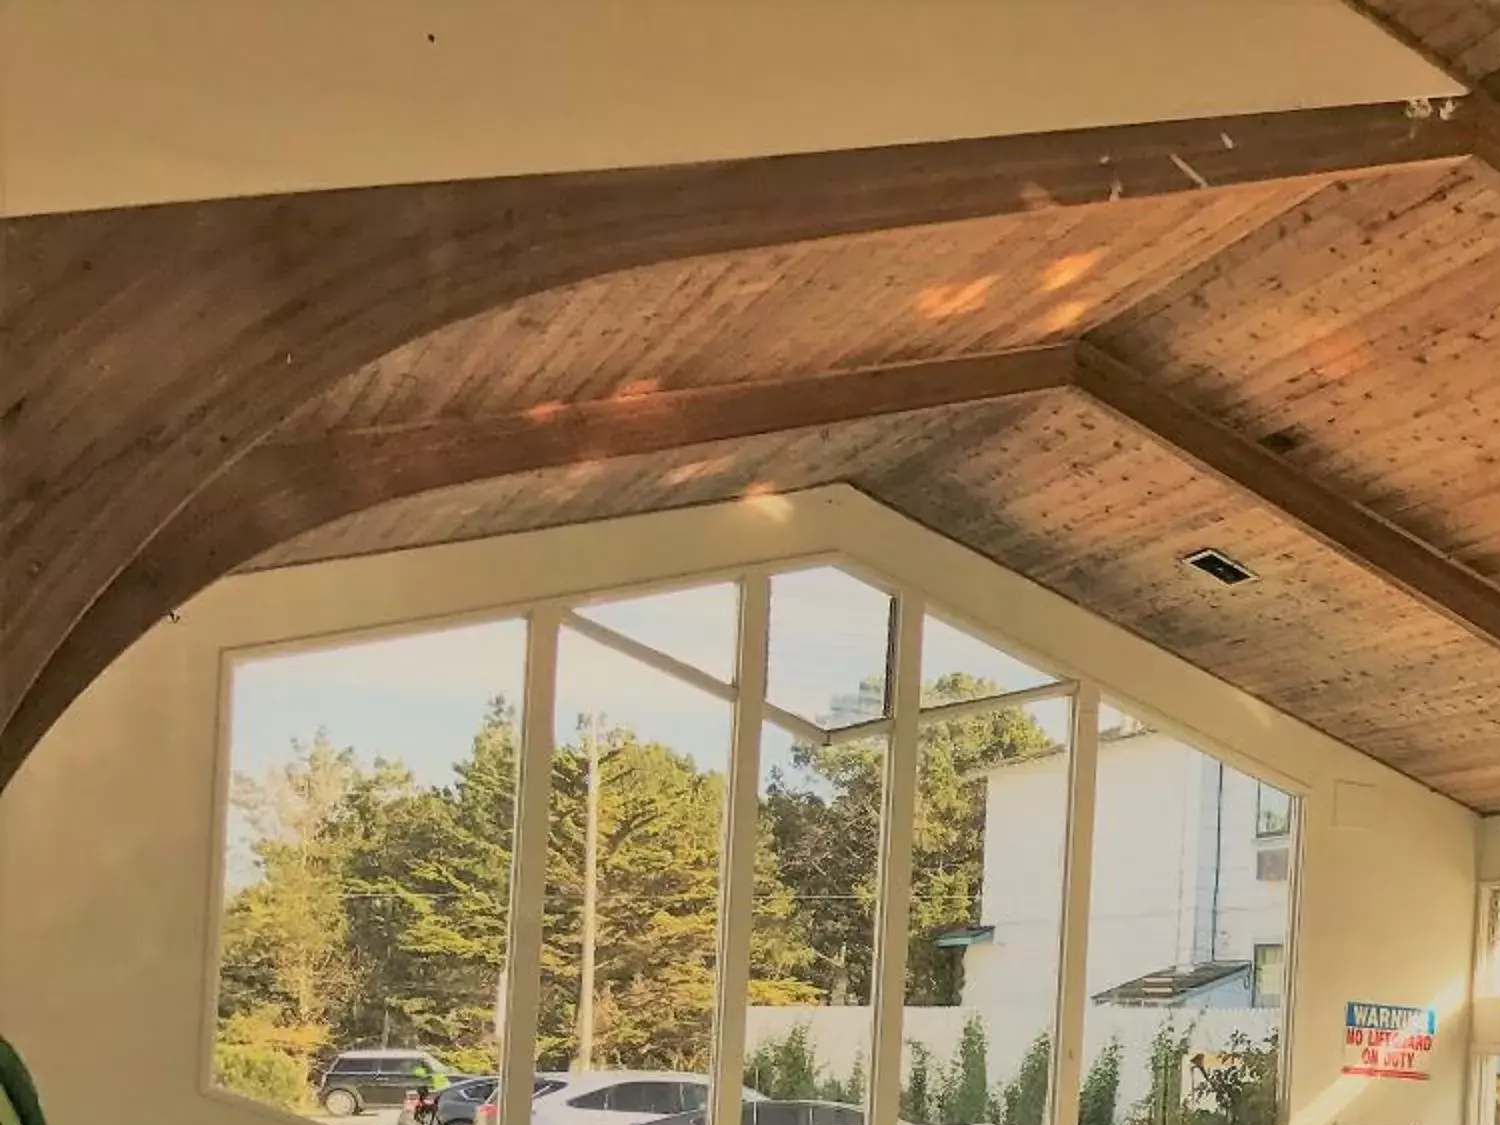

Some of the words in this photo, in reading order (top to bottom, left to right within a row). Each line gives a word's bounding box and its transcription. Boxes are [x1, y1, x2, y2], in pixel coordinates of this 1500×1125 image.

[1353, 1005, 1426, 1031] WARNI
[1346, 1028, 1363, 1045] NO
[1368, 1030, 1432, 1050] LIFEARD
[1362, 1048, 1378, 1064] ON
